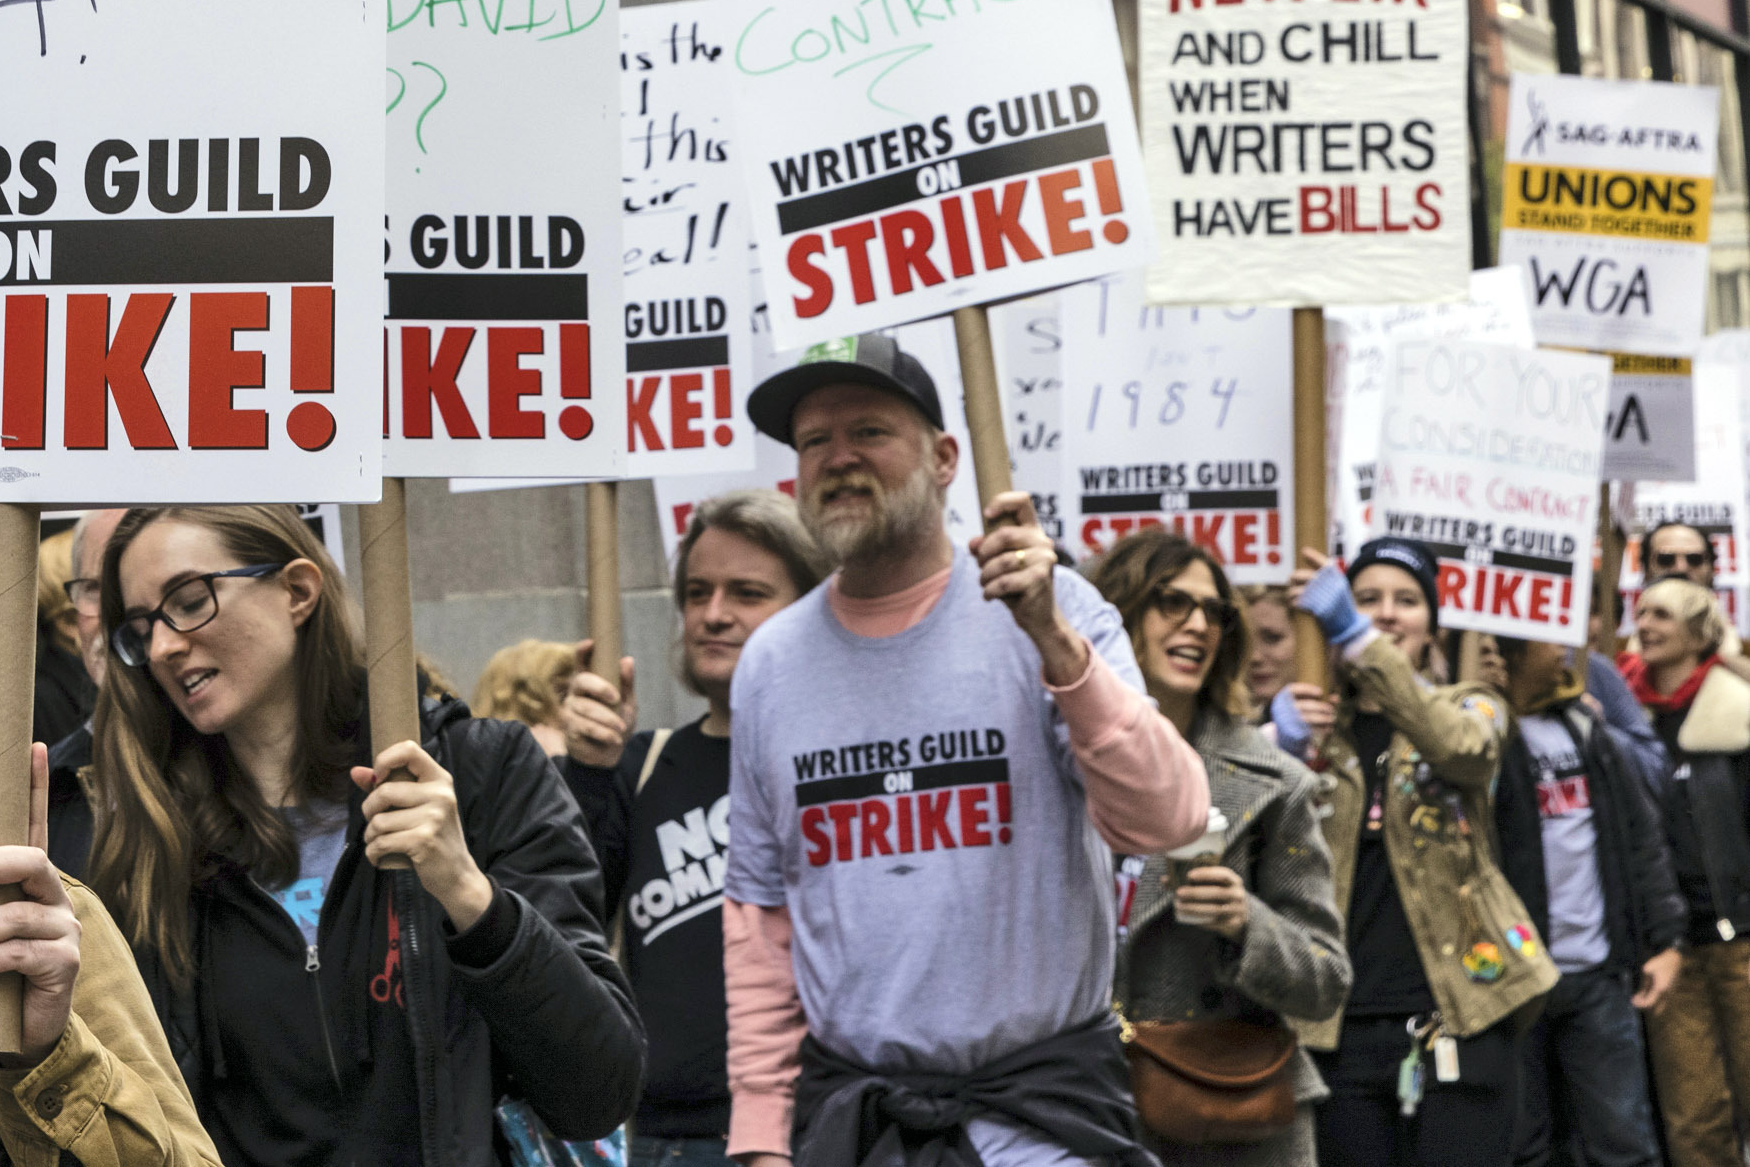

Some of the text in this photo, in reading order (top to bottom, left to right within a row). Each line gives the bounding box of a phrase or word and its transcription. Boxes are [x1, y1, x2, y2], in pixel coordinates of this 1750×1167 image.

[661, 21, 723, 65] the
[1171, 20, 1440, 67] AND CHILL
[1169, 79, 1290, 114] WHEN
[629, 112, 731, 171] this
[770, 82, 1100, 198] WRITERS GUILD
[1172, 119, 1436, 176] WRITERS
[84, 136, 332, 215] GUILD
[915, 159, 962, 197] ON
[1519, 168, 1698, 216] UNIONS
[1173, 182, 1444, 238] HAVE BILLS
[410, 213, 585, 270] GUILD
[786, 157, 1130, 319] STRIKE!
[1529, 255, 1654, 317] WGA
[624, 295, 727, 339] GUILD
[383, 323, 594, 442] KE!
[1086, 377, 1239, 432] 1984
[1394, 339, 1487, 410] FOR
[1512, 354, 1606, 430] YOUR
[1605, 393, 1651, 444] A
[1079, 458, 1279, 491] WRITERS GUILD
[1410, 465, 1475, 510] FAIR
[1080, 508, 1281, 566] SKE!
[1385, 510, 1576, 555] WRITERS GUILD
[793, 727, 1006, 781] WRITERS GUILD
[883, 770, 914, 794] ON
[800, 781, 1013, 868] STRIKE!
